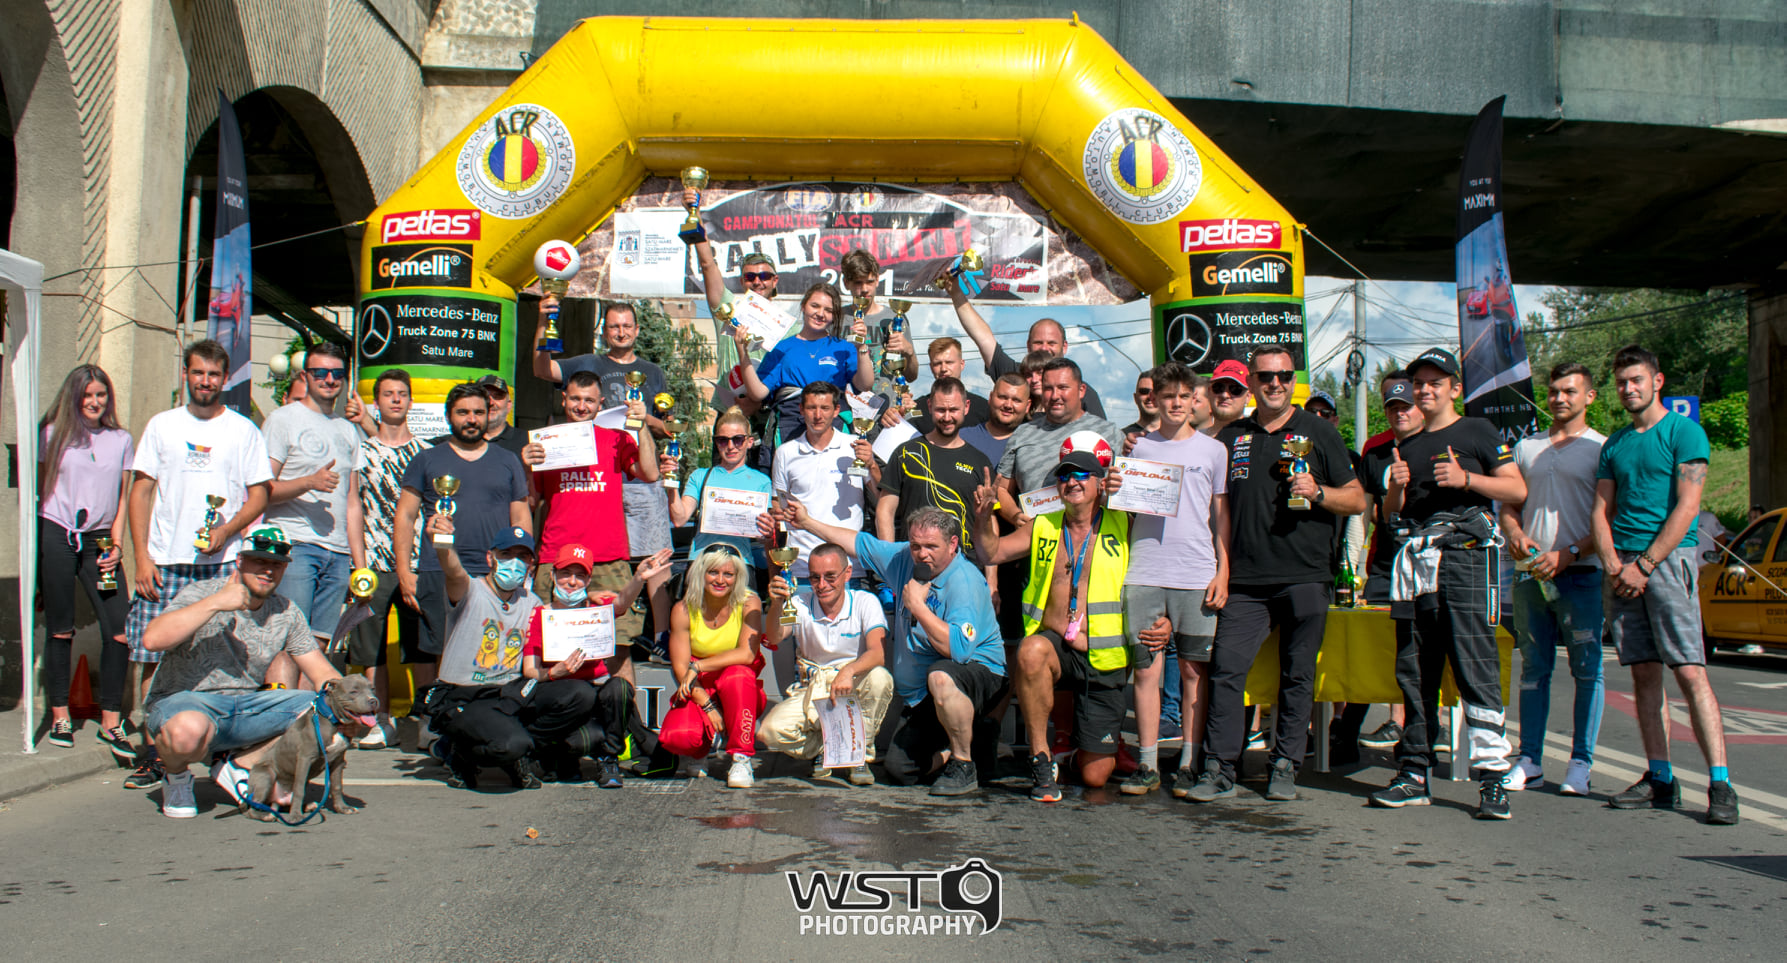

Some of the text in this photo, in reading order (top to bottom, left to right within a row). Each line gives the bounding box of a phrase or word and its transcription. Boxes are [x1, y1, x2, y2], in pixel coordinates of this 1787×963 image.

[495, 110, 539, 142] ACR
[1117, 115, 1163, 145] ACR
[724, 213, 874, 231] CAMPIONATUL ACR
[395, 304, 500, 324] Mercedes-Benz
[397, 325, 497, 342] Truck Zone 75 BNK
[1219, 333, 1250, 344] Truck
[1252, 332, 1278, 344] Zone
[1278, 332, 1290, 343] 75
[421, 344, 474, 358] Satu Mare
[560, 471, 604, 482] RALLY
[1124, 469, 1172, 481] DIPLOMA
[559, 481, 607, 493] SPRINT
[1032, 495, 1060, 507] DIPLO
[1714, 571, 1748, 596] ACR
[740, 708, 753, 745] OMP
